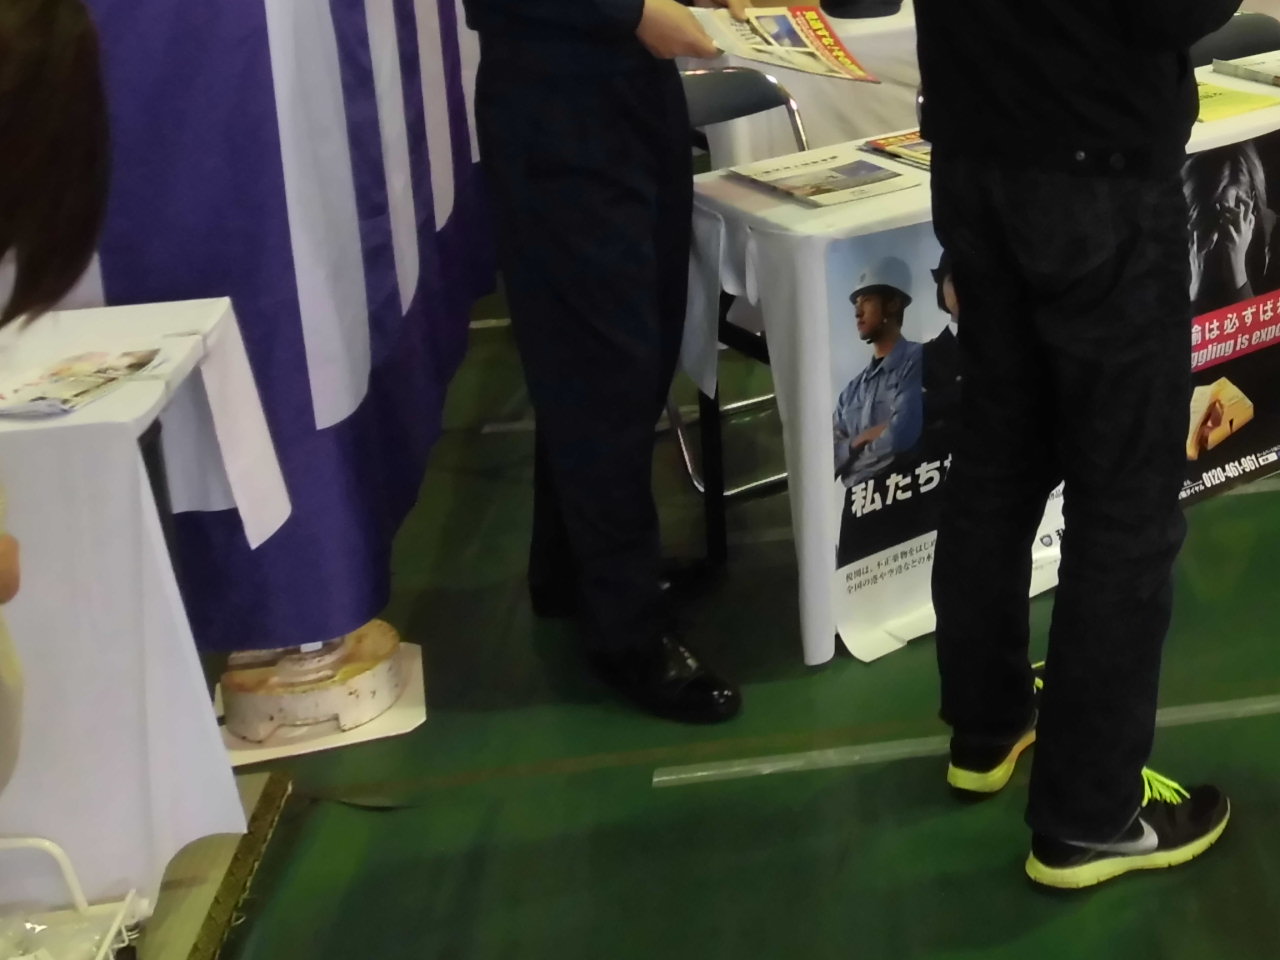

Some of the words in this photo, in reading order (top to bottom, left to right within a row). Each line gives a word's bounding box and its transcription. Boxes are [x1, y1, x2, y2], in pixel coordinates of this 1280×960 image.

[1236, 334, 1250, 351] is
[851, 453, 952, 518] 私たち
[1202, 453, 1260, 488] 0120-461-961
